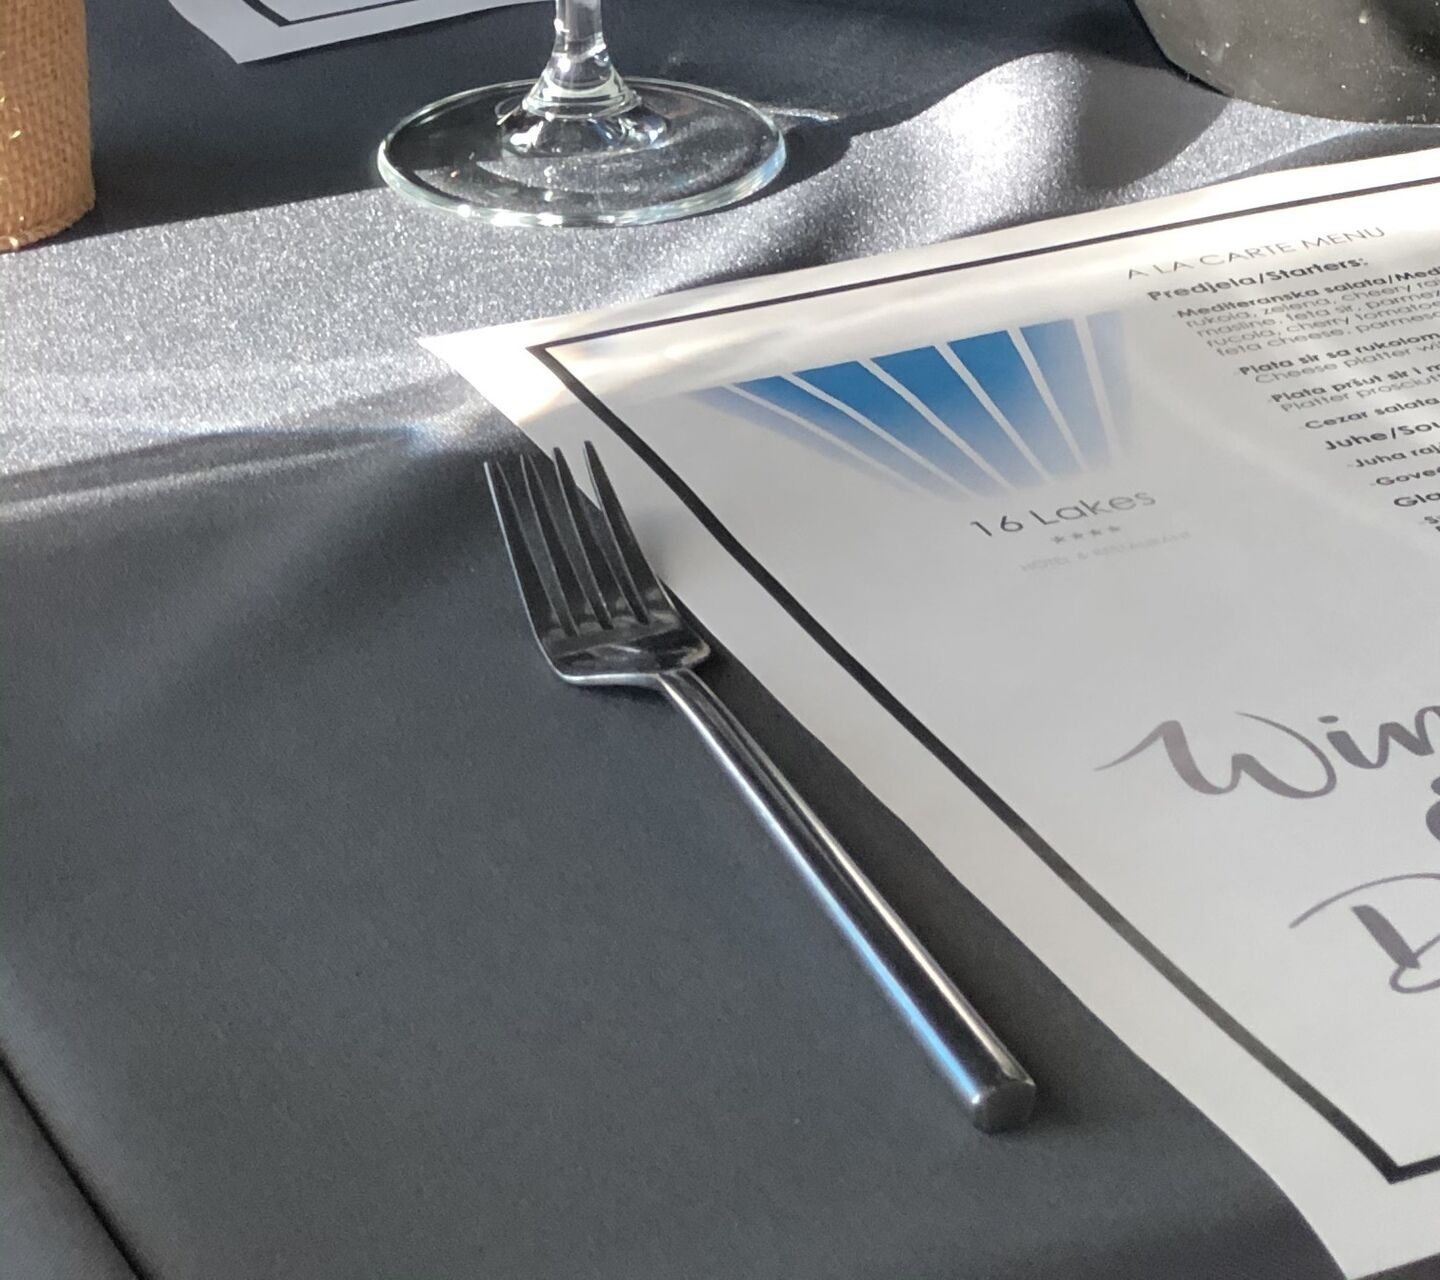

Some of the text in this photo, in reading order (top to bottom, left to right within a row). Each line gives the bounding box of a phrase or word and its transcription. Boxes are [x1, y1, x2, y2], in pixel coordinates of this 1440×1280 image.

[1127, 227, 1385, 280] A LA CARTE MENU
[1297, 353, 1320, 364] sir
[1325, 348, 1351, 359] sa
[1354, 332, 1440, 353] rukolom
[1330, 374, 1382, 392] pršut
[1386, 370, 1408, 380] sir
[970, 492, 1155, 536] 16 Lakes
